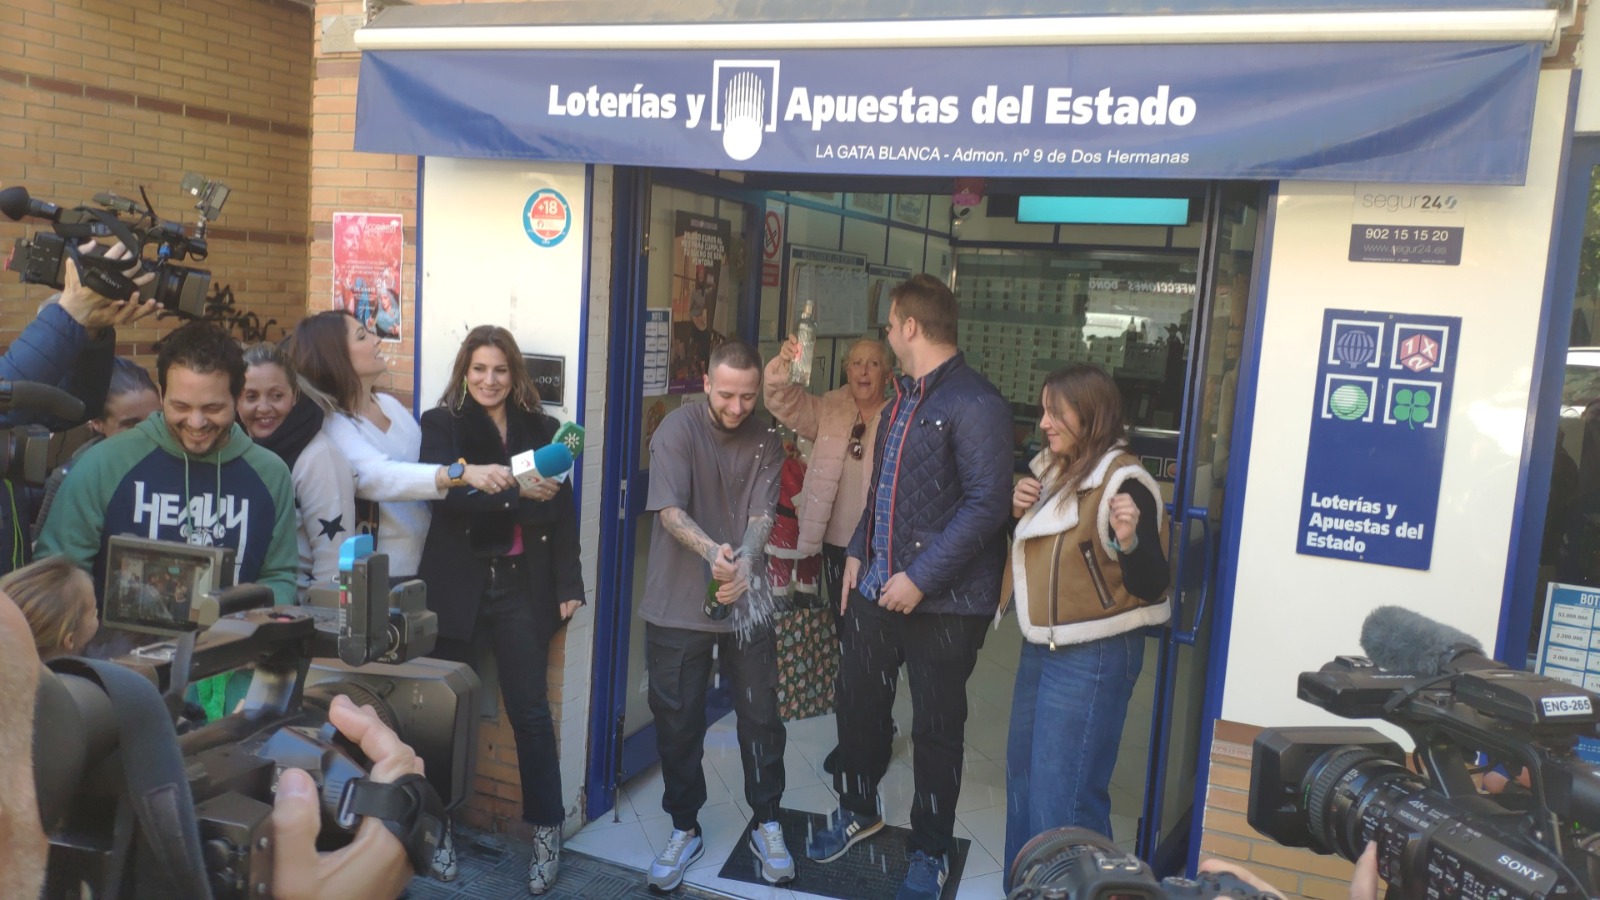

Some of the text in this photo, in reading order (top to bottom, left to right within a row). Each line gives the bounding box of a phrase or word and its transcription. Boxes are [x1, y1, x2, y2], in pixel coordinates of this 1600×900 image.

[548, 83, 706, 129] Loterías y
[783, 84, 1197, 132] Apuestas del Estado
[815, 144, 834, 159] LA
[836, 145, 876, 161] GATA
[878, 146, 941, 162] BLANCA
[952, 147, 1008, 164] Admon.
[1033, 149, 1044, 164] 9
[1047, 149, 1067, 164] de
[1071, 149, 1103, 165] Dos
[1106, 150, 1190, 165] Hermanas
[538, 200, 558, 215] +18
[1362, 193, 1442, 213] segur24
[1365, 228, 1449, 242] 902 15 15 20
[1311, 492, 1397, 520] Loterías y
[133, 481, 249, 586] HEAVY
[1309, 512, 1424, 540] Apuestas del
[1306, 531, 1366, 553] Estado
[1581, 593, 1600, 606] BOT
[1543, 699, 1591, 712] ENG-265
[1408, 800, 1429, 812] 4K
[1497, 855, 1544, 881] SONY
